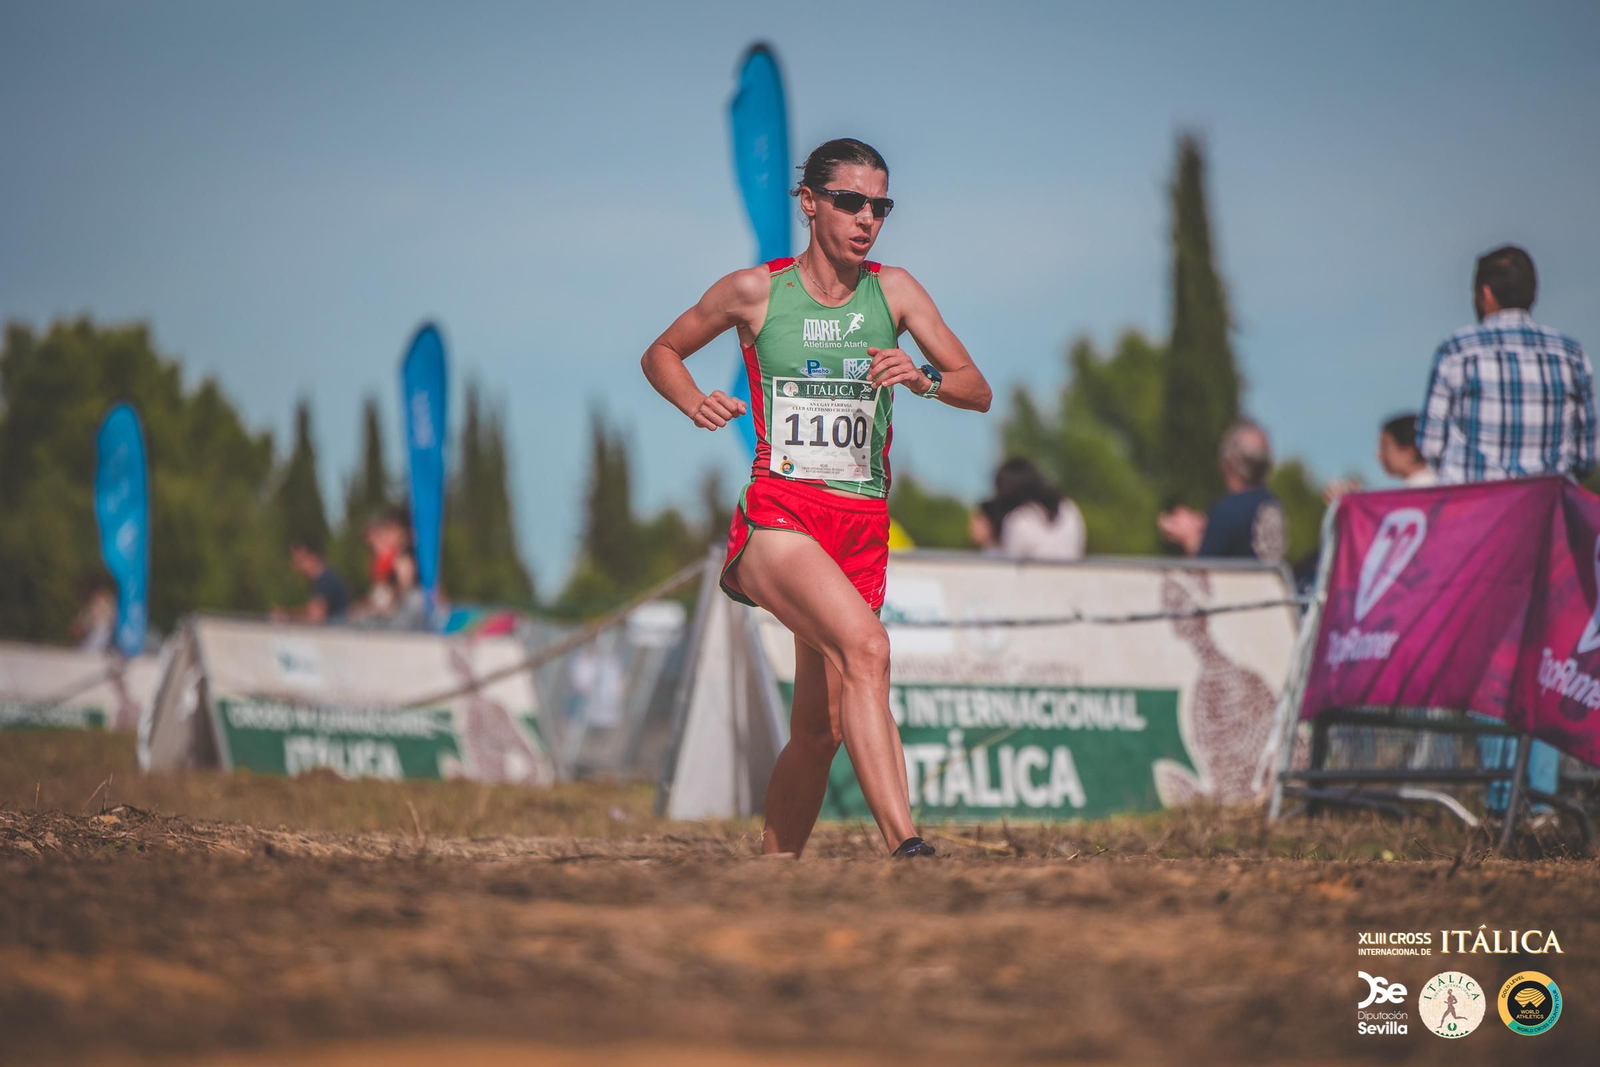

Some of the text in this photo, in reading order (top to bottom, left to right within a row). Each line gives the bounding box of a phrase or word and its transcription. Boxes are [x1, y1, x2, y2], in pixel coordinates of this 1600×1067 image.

[803, 319, 842, 341] ATARFE
[806, 382, 855, 396] ITÁLICA
[785, 413, 867, 449] 1100
[906, 688, 1146, 731] INTERNACIONAL
